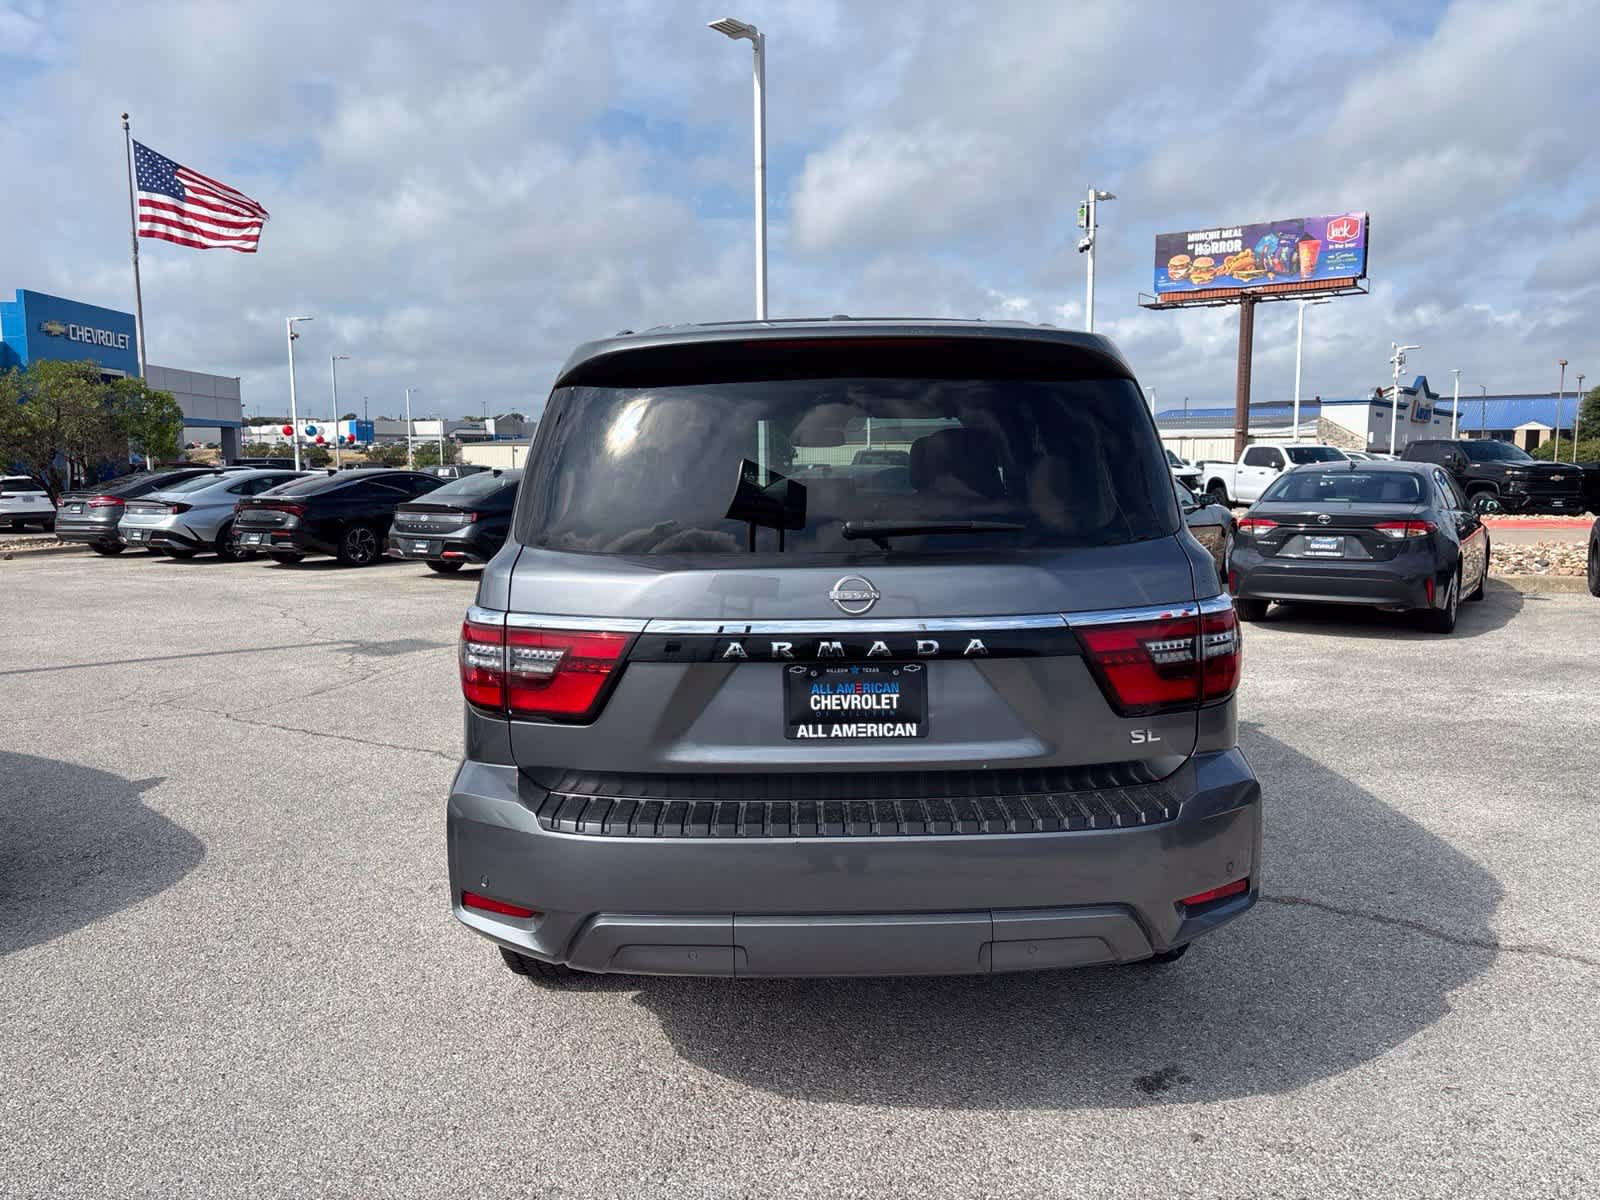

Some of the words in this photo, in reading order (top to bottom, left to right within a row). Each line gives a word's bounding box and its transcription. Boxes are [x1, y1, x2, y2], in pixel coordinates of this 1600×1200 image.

[1187, 232, 1220, 242] MUNCHIE
[1221, 228, 1242, 239] MEAL
[1194, 239, 1242, 256] HORROR
[69, 323, 130, 350] CHEVROLET
[829, 590, 880, 600] NISSAN
[723, 638, 988, 658] ARMADA
[811, 683, 833, 694] ALL
[836, 682, 900, 694] AMERICAN
[810, 694, 900, 710] CHEVROLET
[796, 724, 827, 738] ALL
[830, 723, 917, 737] AMERICAN
[1130, 729, 1161, 744] SL
